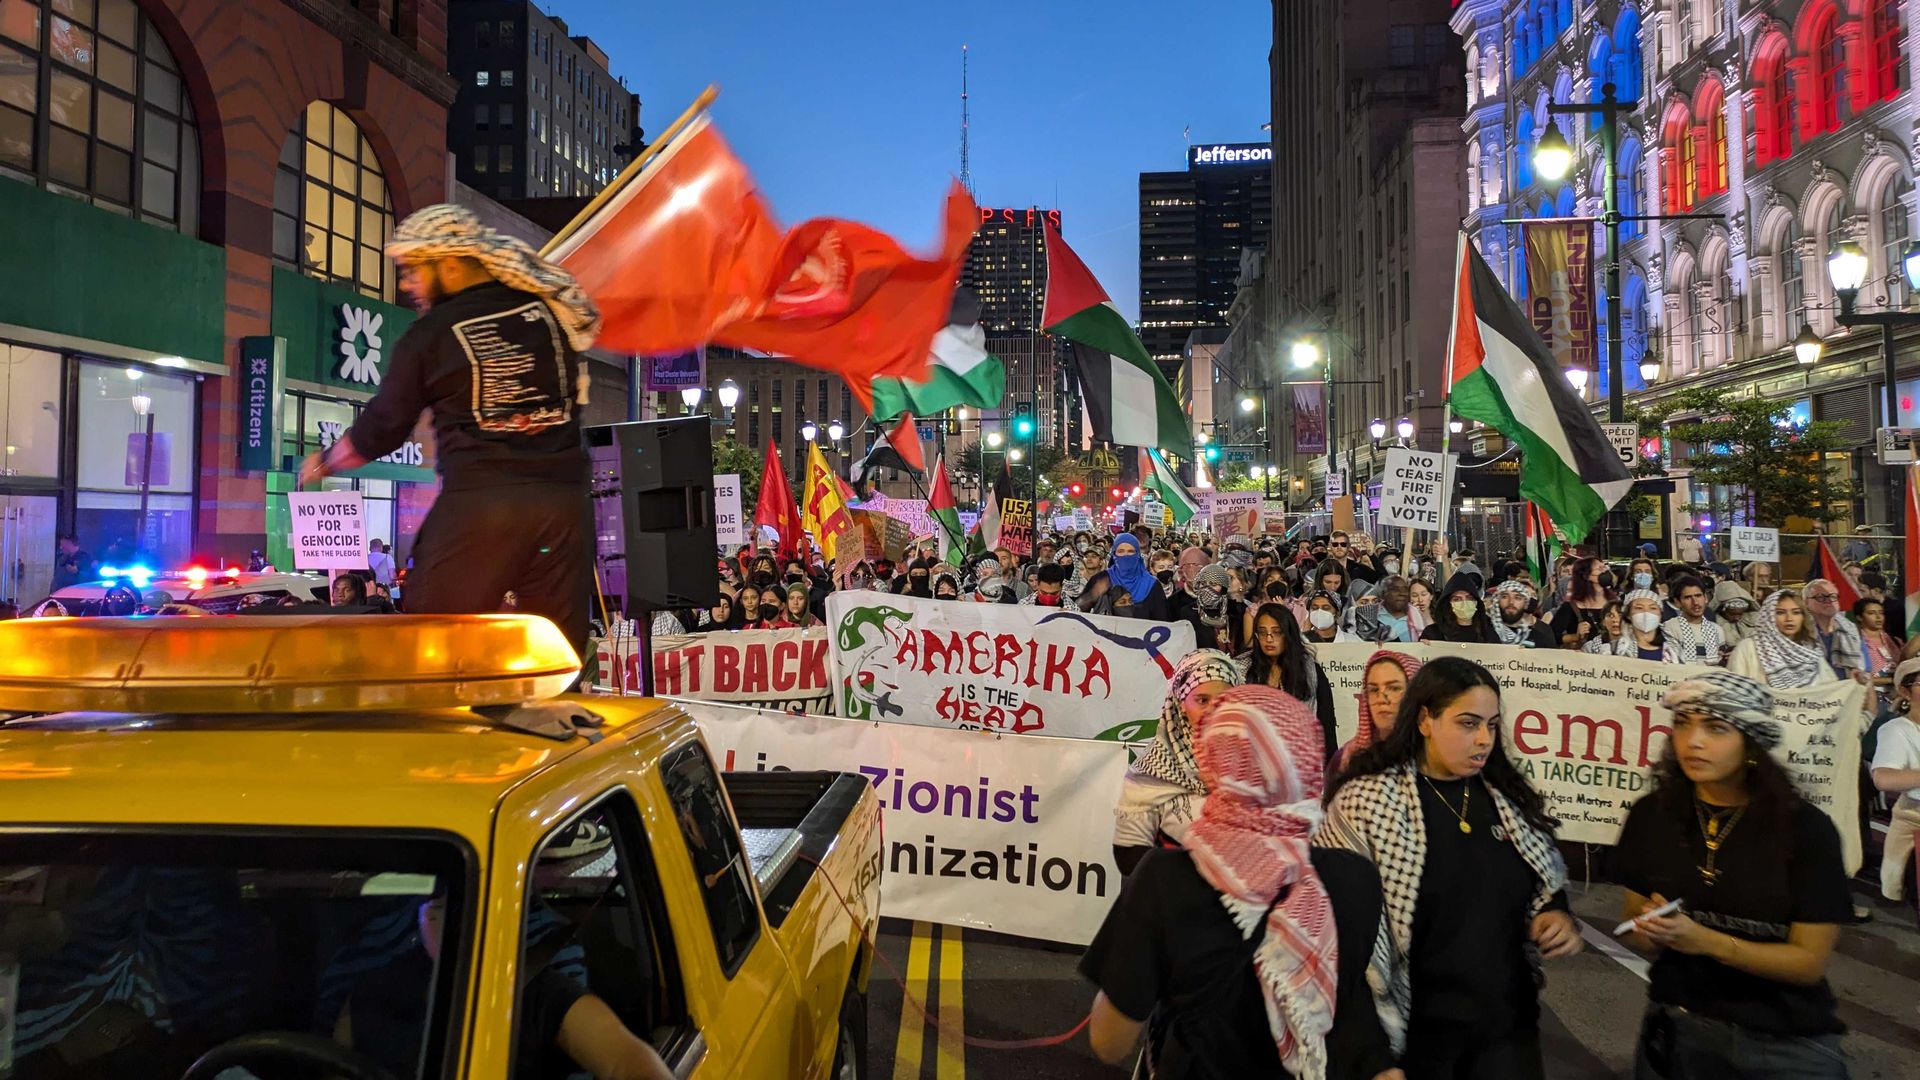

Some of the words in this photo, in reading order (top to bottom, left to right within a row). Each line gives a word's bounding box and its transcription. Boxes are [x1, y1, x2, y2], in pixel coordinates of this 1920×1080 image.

[1194, 145, 1272, 163] Jefferson
[981, 208, 1060, 227] PSFS
[249, 377, 265, 448] Citizens
[1603, 428, 1635, 436] SPEED
[1408, 455, 1434, 468] NO
[1620, 446, 1634, 463] 5
[1395, 467, 1443, 483] CEASE
[1400, 481, 1434, 495] FIRE
[1216, 499, 1229, 507] NO
[1230, 497, 1257, 506] VOTES
[1403, 494, 1428, 507] NO
[298, 504, 316, 517] NO
[318, 503, 358, 516] VOTES
[1390, 506, 1438, 523] VOTE
[316, 519, 342, 532] FOR
[716, 513, 736, 525] IDE
[300, 535, 361, 547] GENOCIDE
[1001, 524, 1033, 542] WAR
[1738, 531, 1752, 540] LET
[302, 549, 320, 557] TAKE
[335, 550, 361, 558] PLEDGE
[713, 639, 830, 694] BACK
[892, 627, 1112, 701] AMERIKA
[960, 683, 976, 700] IS
[983, 686, 1019, 708] THE
[1567, 684, 1616, 698] Jordanian
[1626, 687, 1650, 701] Field
[935, 684, 1046, 733] HEAD
[1787, 750, 1810, 765] Khan
[1511, 757, 1536, 779] ZA
[1541, 760, 1643, 792] TARGETED
[858, 764, 1040, 825] Zionist
[1576, 793, 1613, 808] Martyrs
[881, 834, 1107, 899] nization
